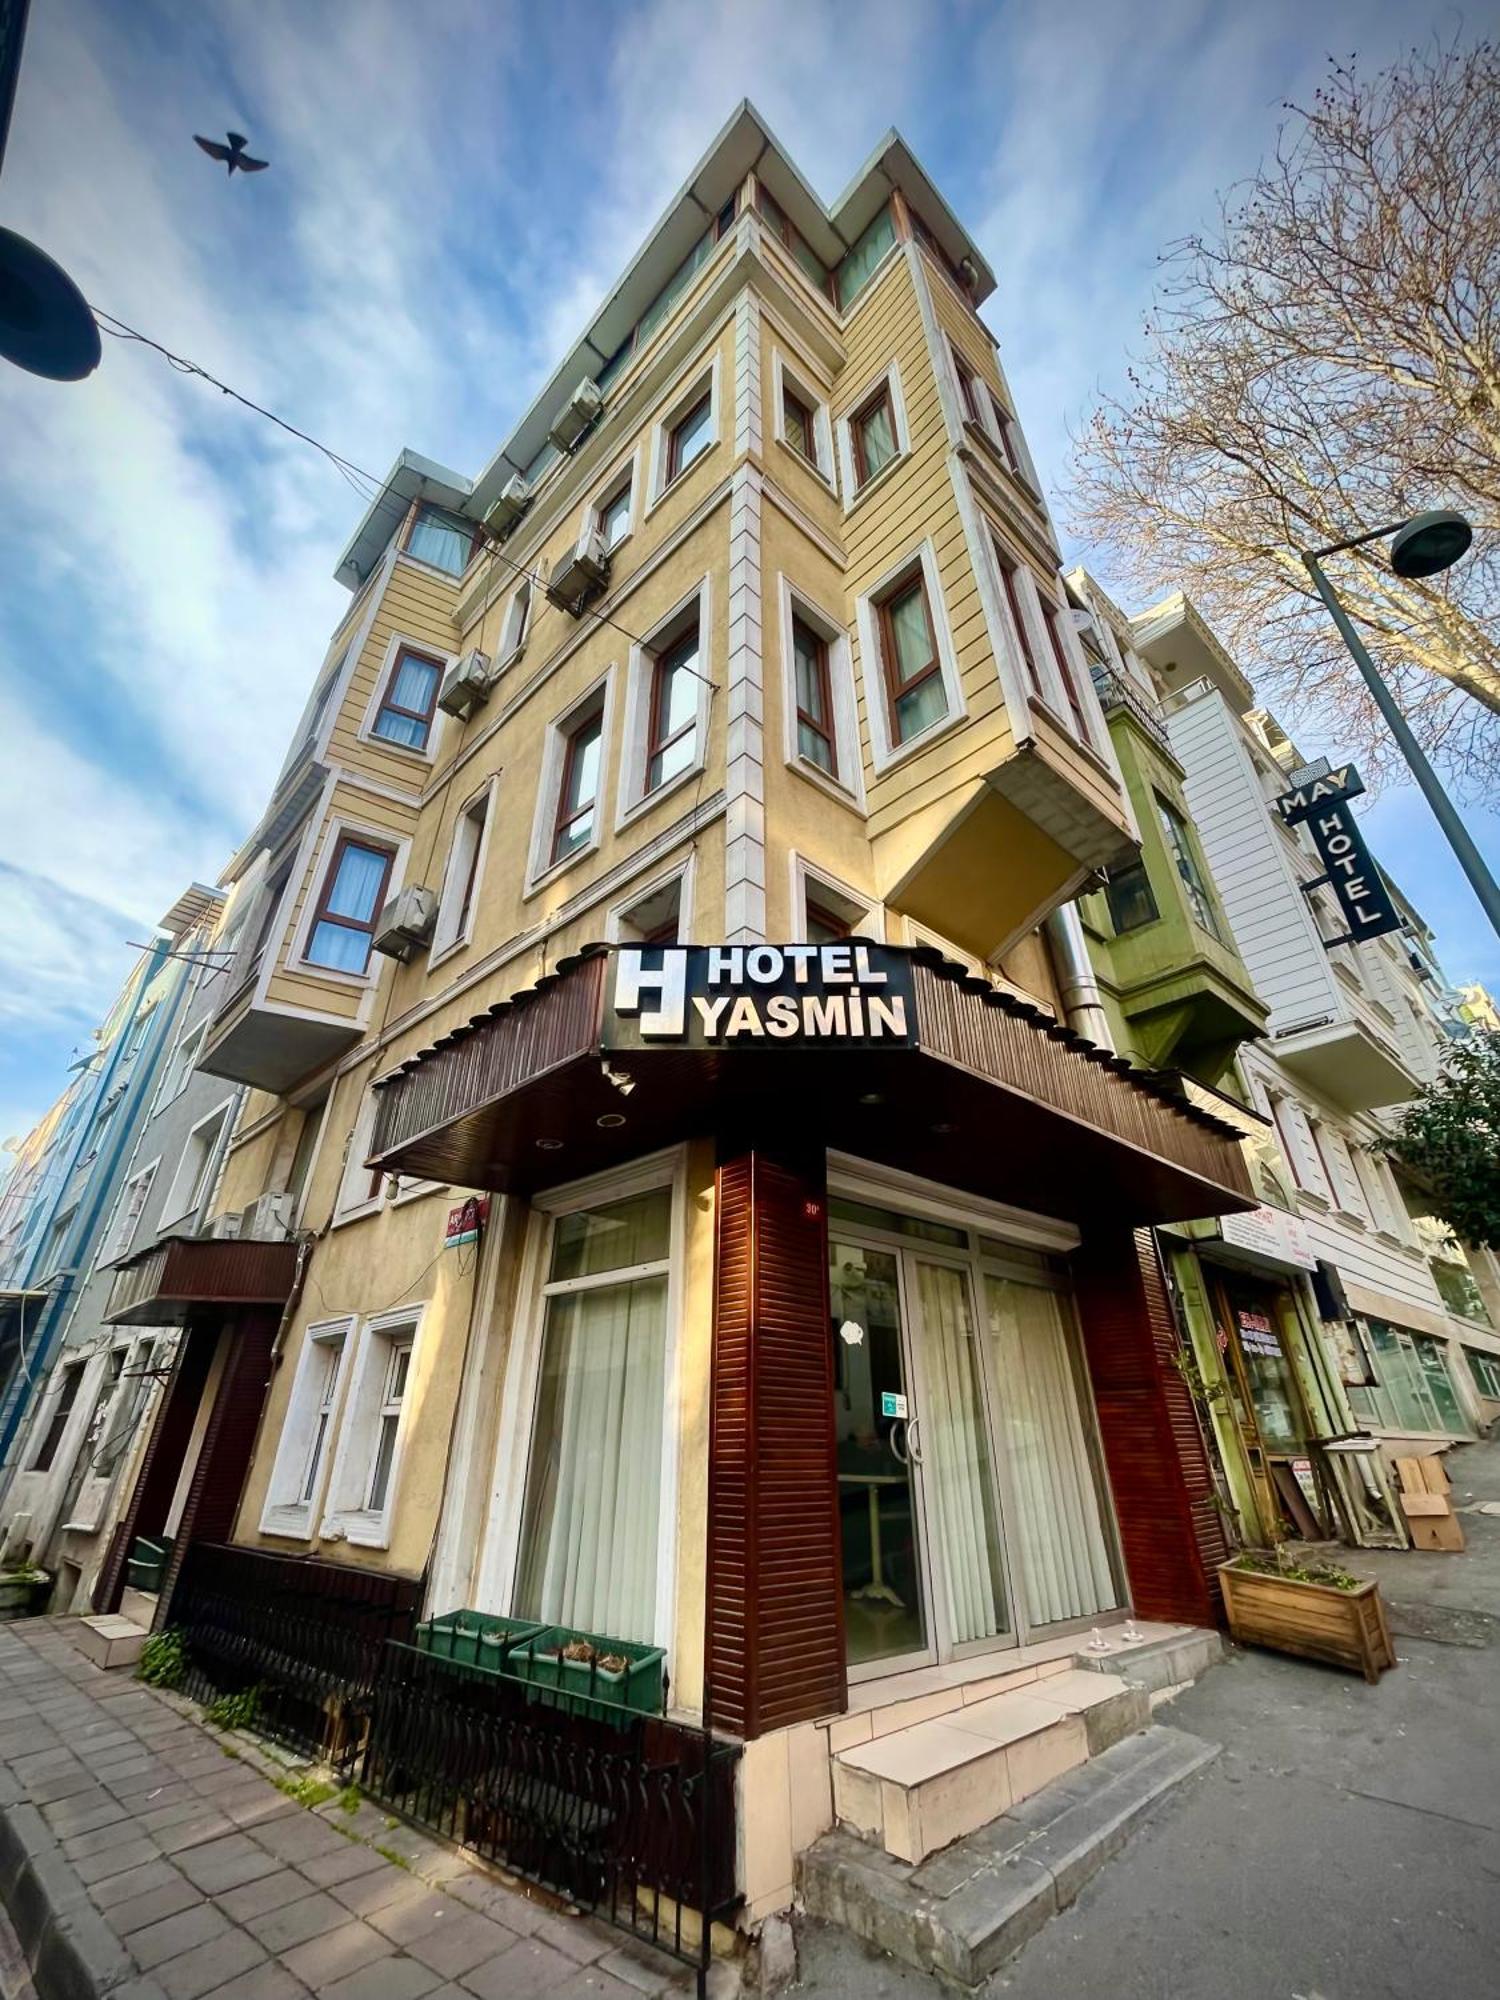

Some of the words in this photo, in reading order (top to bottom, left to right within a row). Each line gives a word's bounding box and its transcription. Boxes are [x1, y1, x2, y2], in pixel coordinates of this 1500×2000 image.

[1281, 768, 1348, 815] MAY
[1318, 812, 1383, 924] HOTEL
[707, 946, 889, 984] HOTEL
[692, 987, 908, 1038] YASMİN
